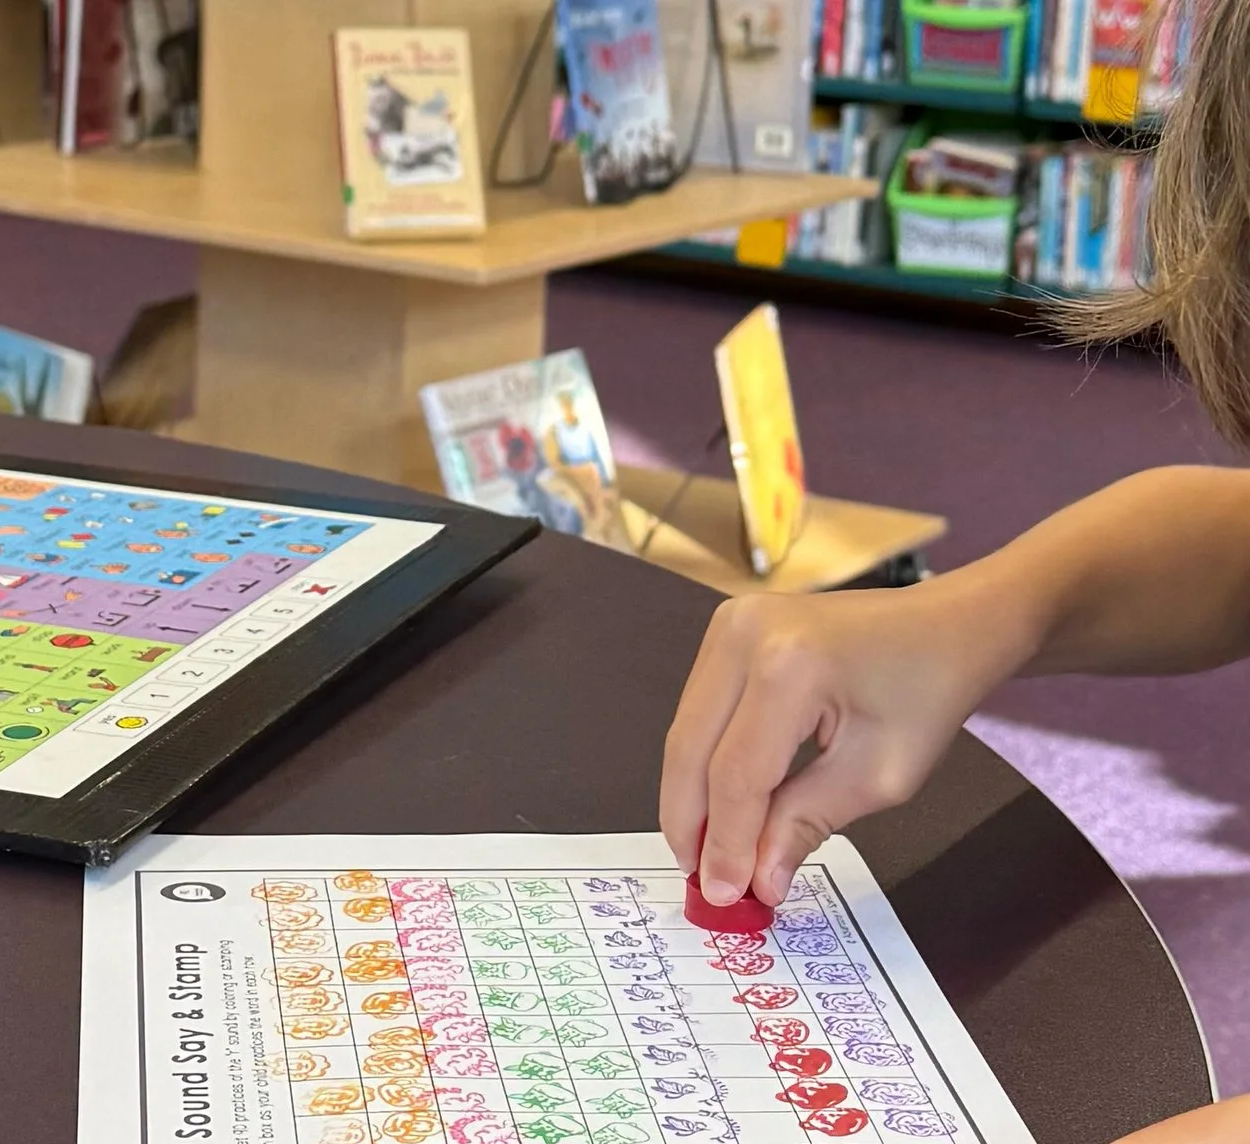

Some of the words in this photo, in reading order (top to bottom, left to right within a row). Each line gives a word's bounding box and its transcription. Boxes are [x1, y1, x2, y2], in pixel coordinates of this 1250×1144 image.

[273, 606, 294, 614] 5
[246, 627, 265, 635] 4
[182, 668, 204, 678] 2
[168, 943, 208, 1000] Stamp
[171, 1008, 204, 1020] &
[171, 1028, 214, 1063] Say
[172, 1072, 212, 1139] Sound
